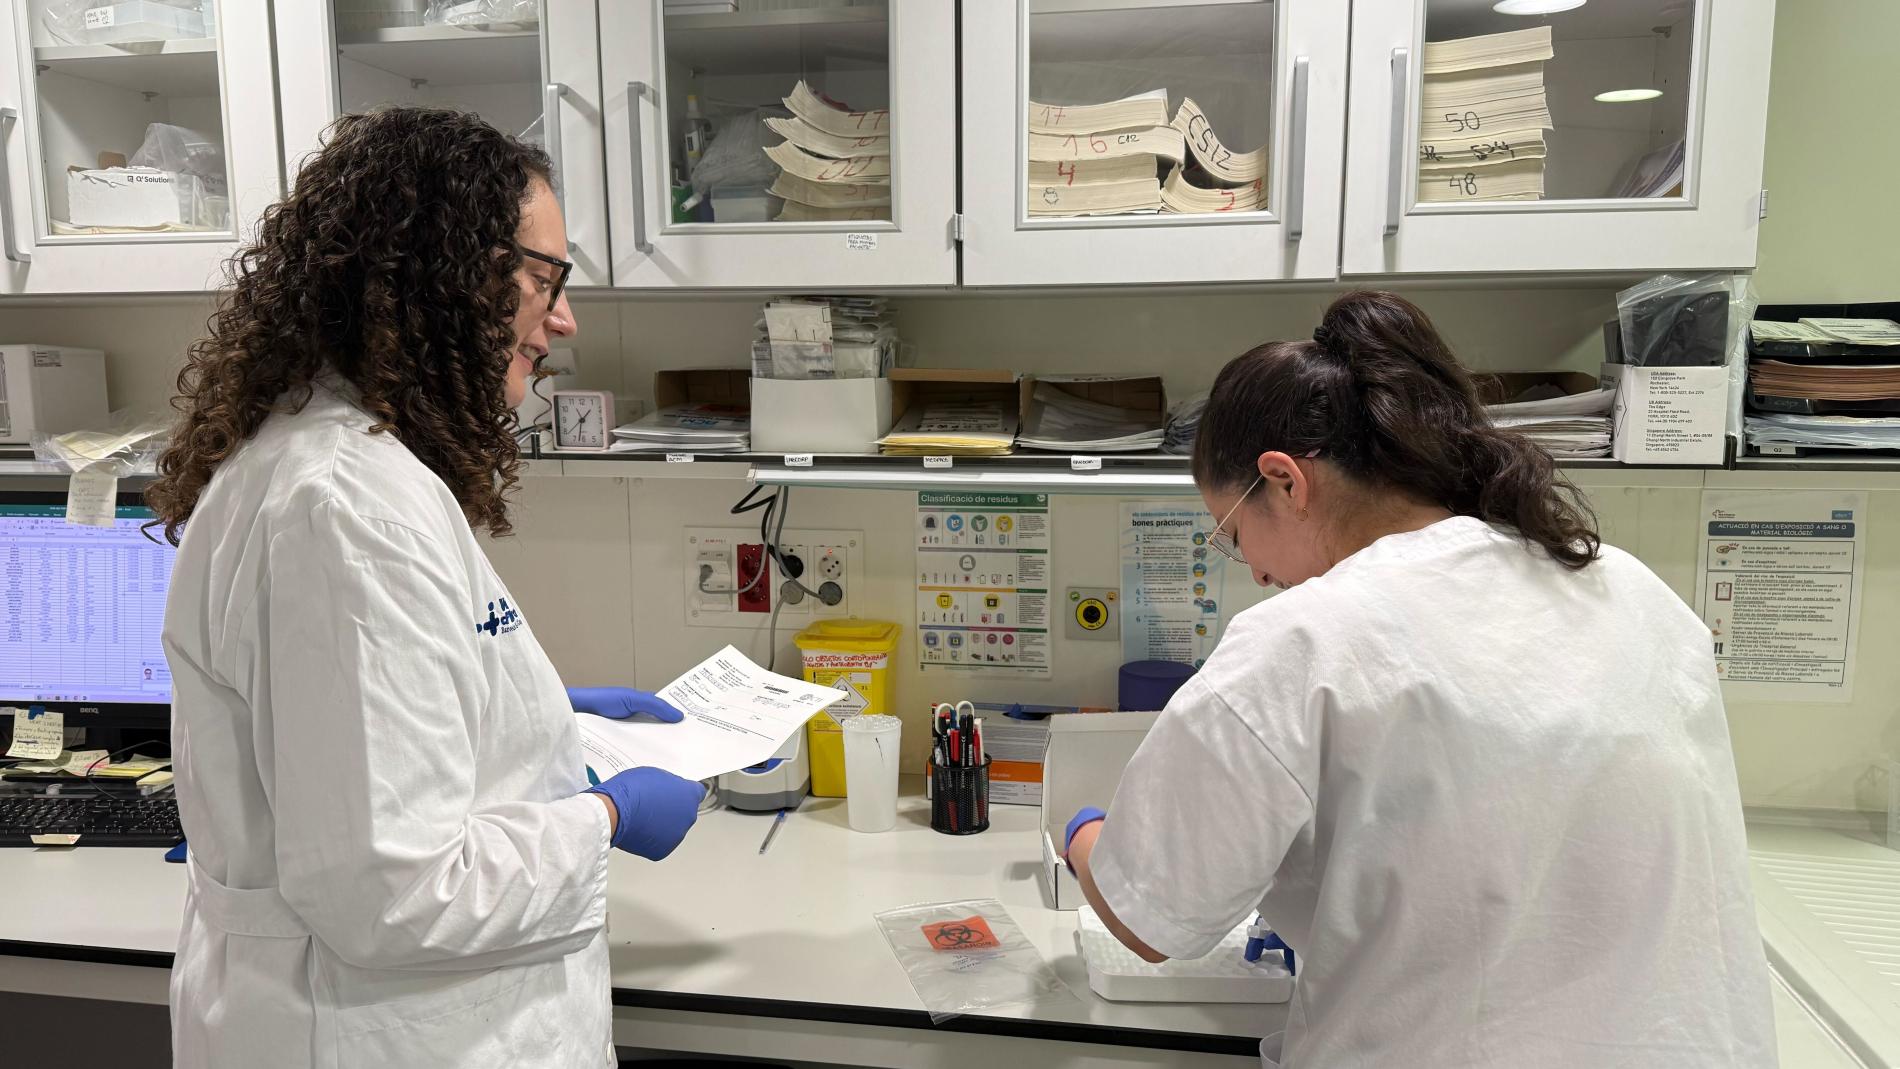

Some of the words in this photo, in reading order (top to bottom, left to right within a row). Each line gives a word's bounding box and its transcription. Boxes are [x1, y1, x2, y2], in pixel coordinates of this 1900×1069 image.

[1445, 111, 1480, 133] 50
[1449, 172, 1477, 196] 48
[975, 495, 986, 503] de
[1132, 519, 1154, 527] bones
